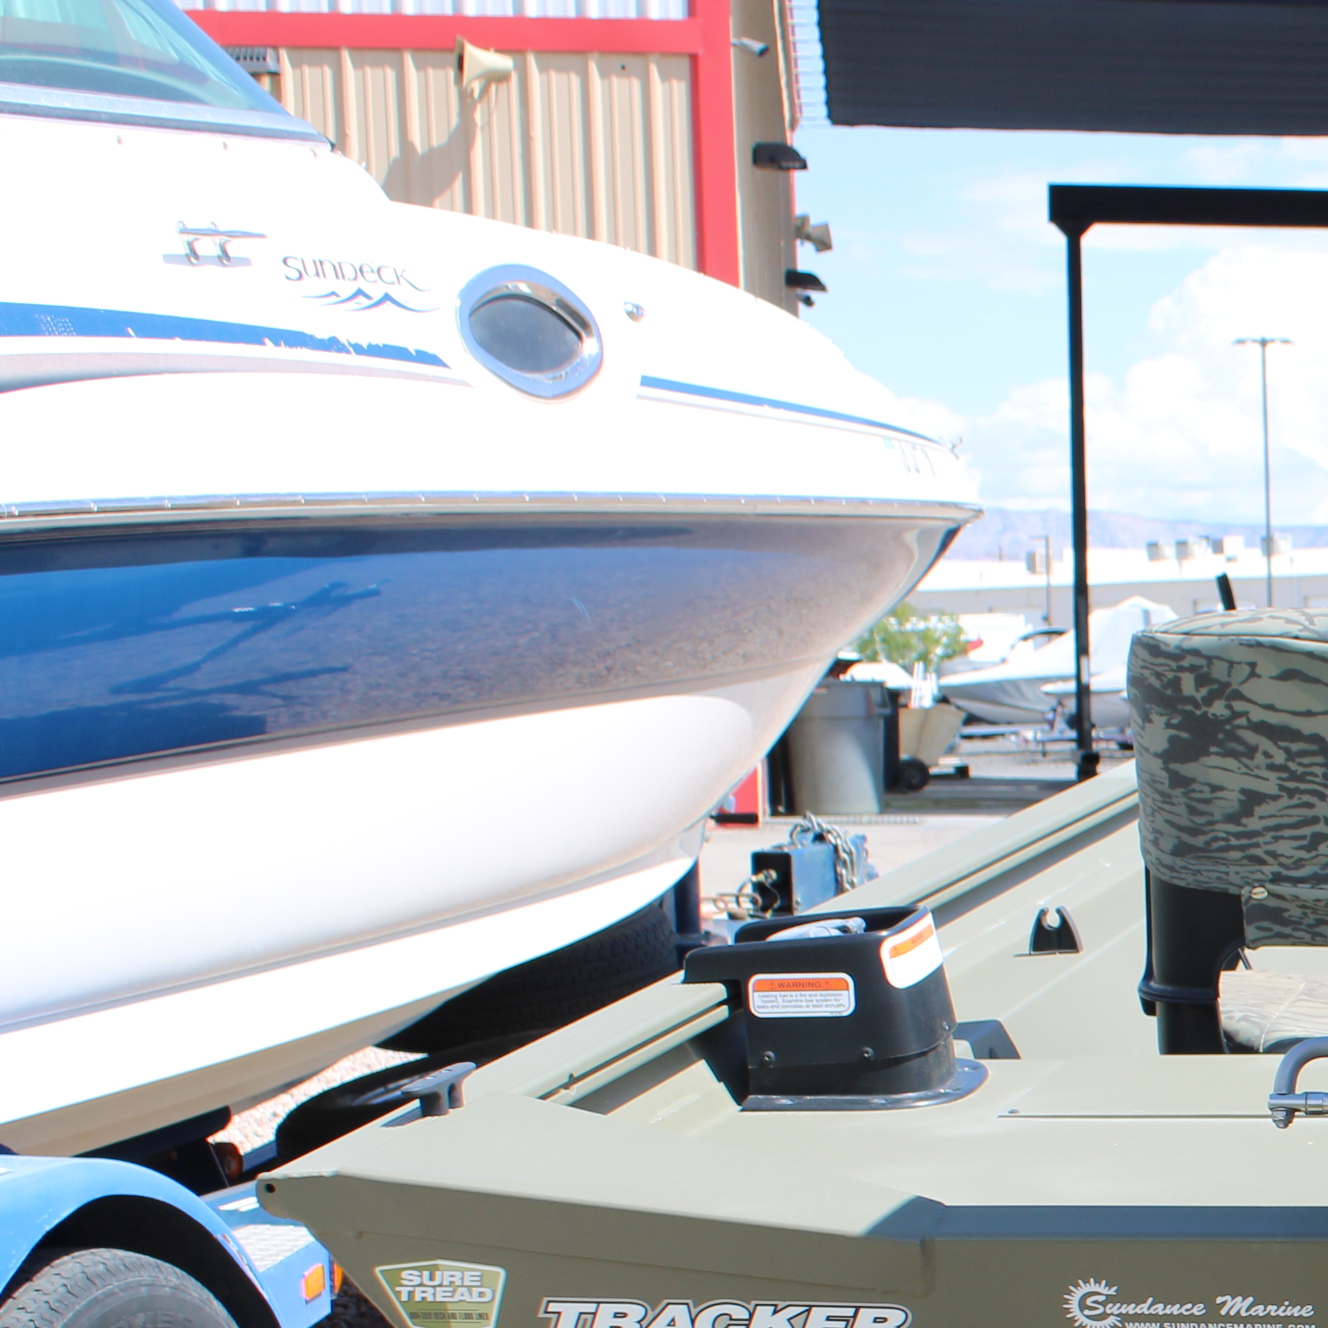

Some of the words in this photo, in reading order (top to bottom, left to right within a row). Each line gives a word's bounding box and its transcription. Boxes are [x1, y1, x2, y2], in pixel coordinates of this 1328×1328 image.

[400, 1270, 482, 1286] SURE
[395, 1287, 494, 1302] TREAD
[1083, 1294, 1206, 1317] Sundance
[1216, 1294, 1314, 1318] Marine
